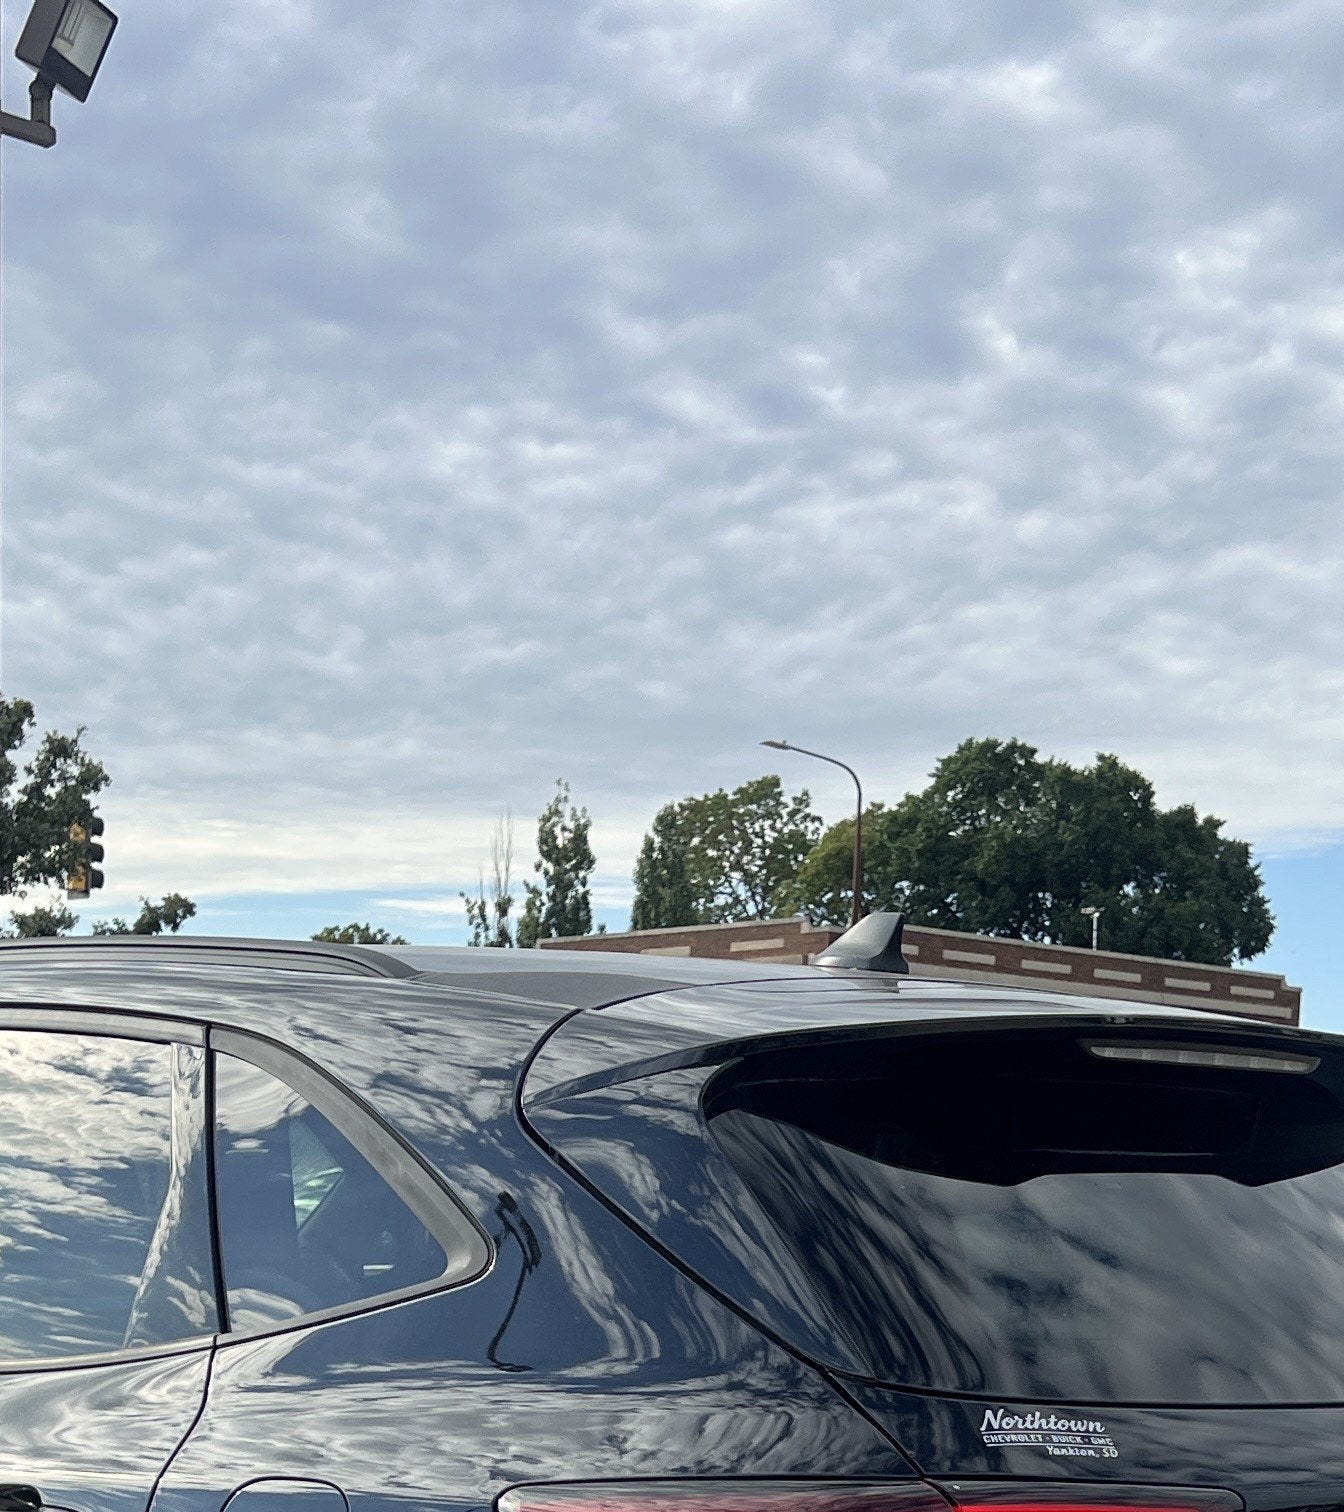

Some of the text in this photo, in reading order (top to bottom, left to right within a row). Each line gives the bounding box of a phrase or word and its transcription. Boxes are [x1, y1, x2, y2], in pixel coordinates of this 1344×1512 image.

[979, 1408, 1106, 1433] Northtown
[982, 1433, 1115, 1447] CHEVROLET BUICK GMC
[1046, 1445, 1119, 1459] Yankton, SD
